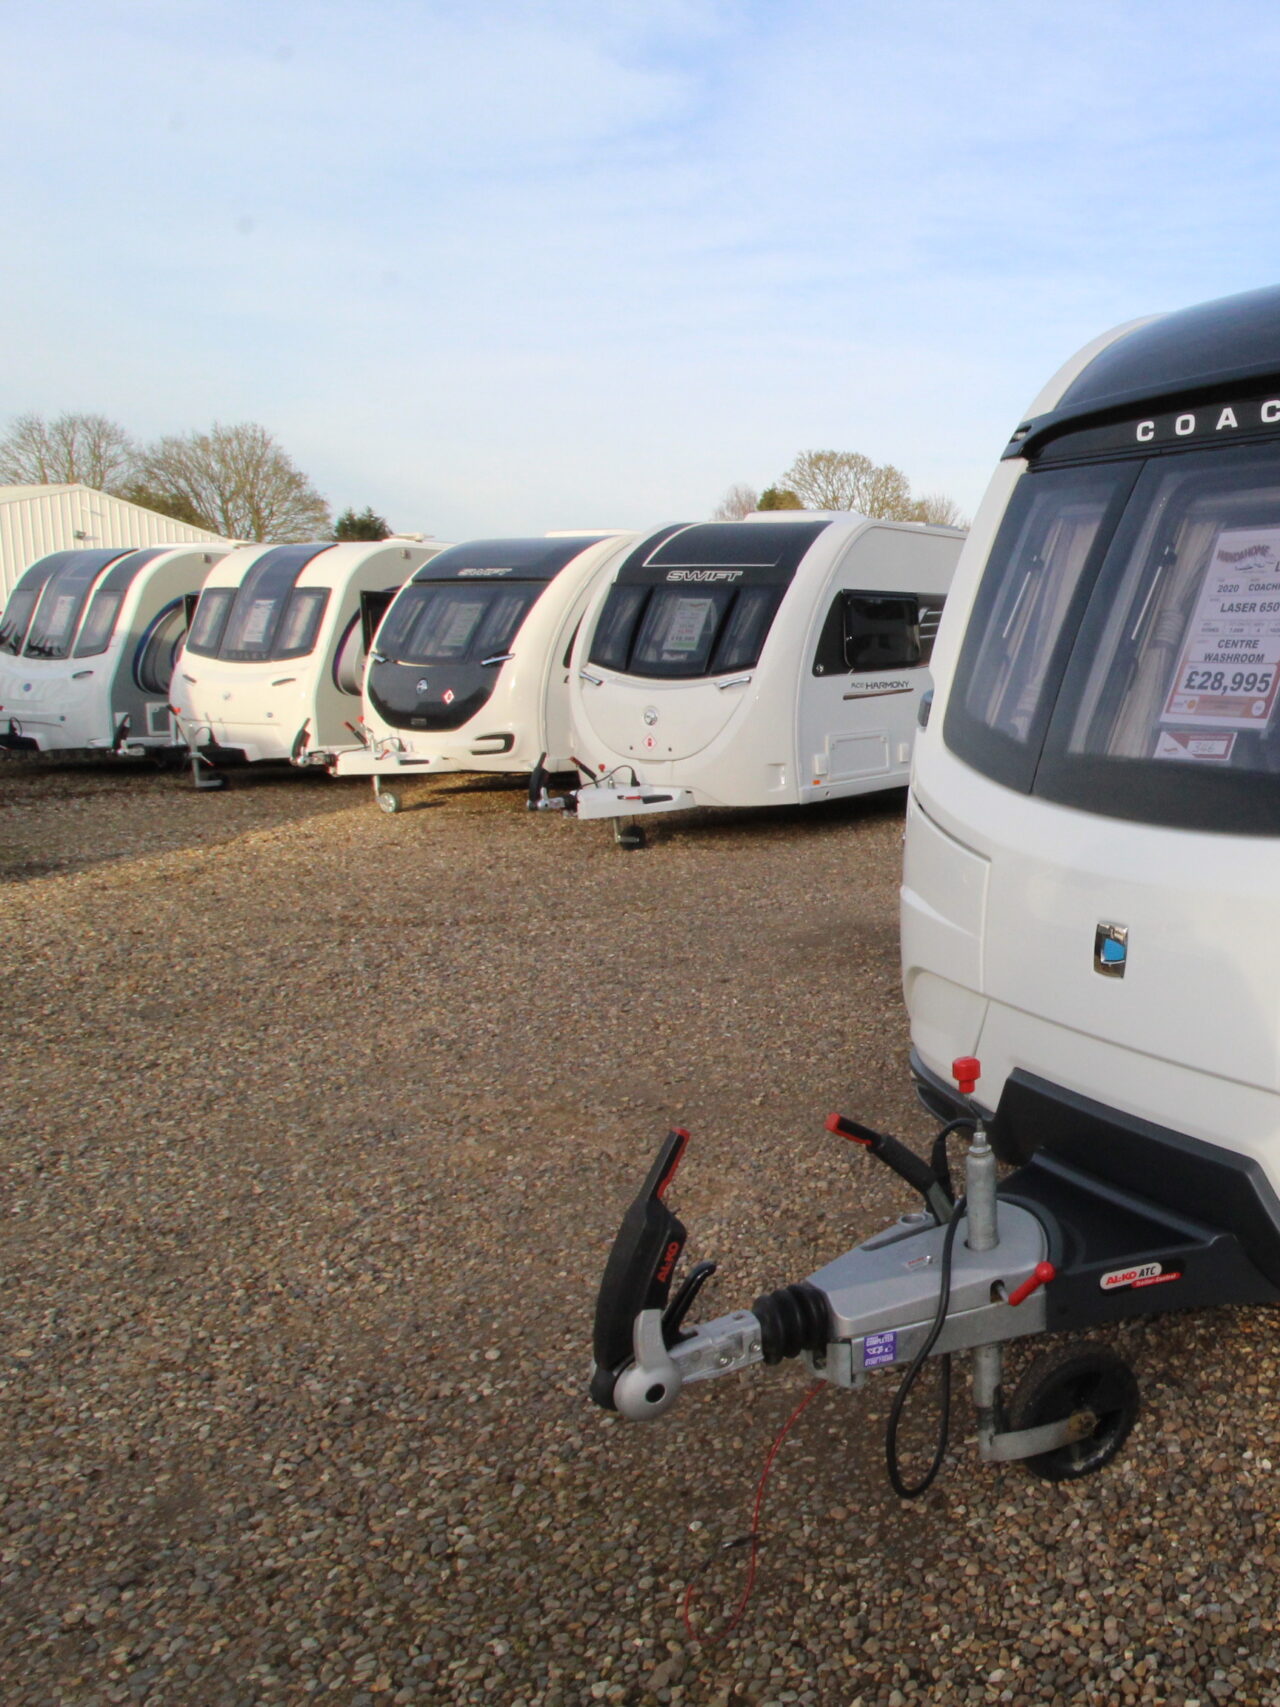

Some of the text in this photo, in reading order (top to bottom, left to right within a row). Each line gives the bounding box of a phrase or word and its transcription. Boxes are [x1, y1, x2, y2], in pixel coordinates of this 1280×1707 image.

[666, 570, 744, 582] SWIFT
[1217, 584, 1240, 593] 2020
[1220, 602, 1280, 613] LASER 650
[1217, 639, 1260, 649] CENTRE
[1204, 653, 1265, 664] WASHROOM
[865, 680, 910, 690] HARMONY
[1184, 670, 1273, 696] £28,995
[1138, 1265, 1157, 1278] ATC
